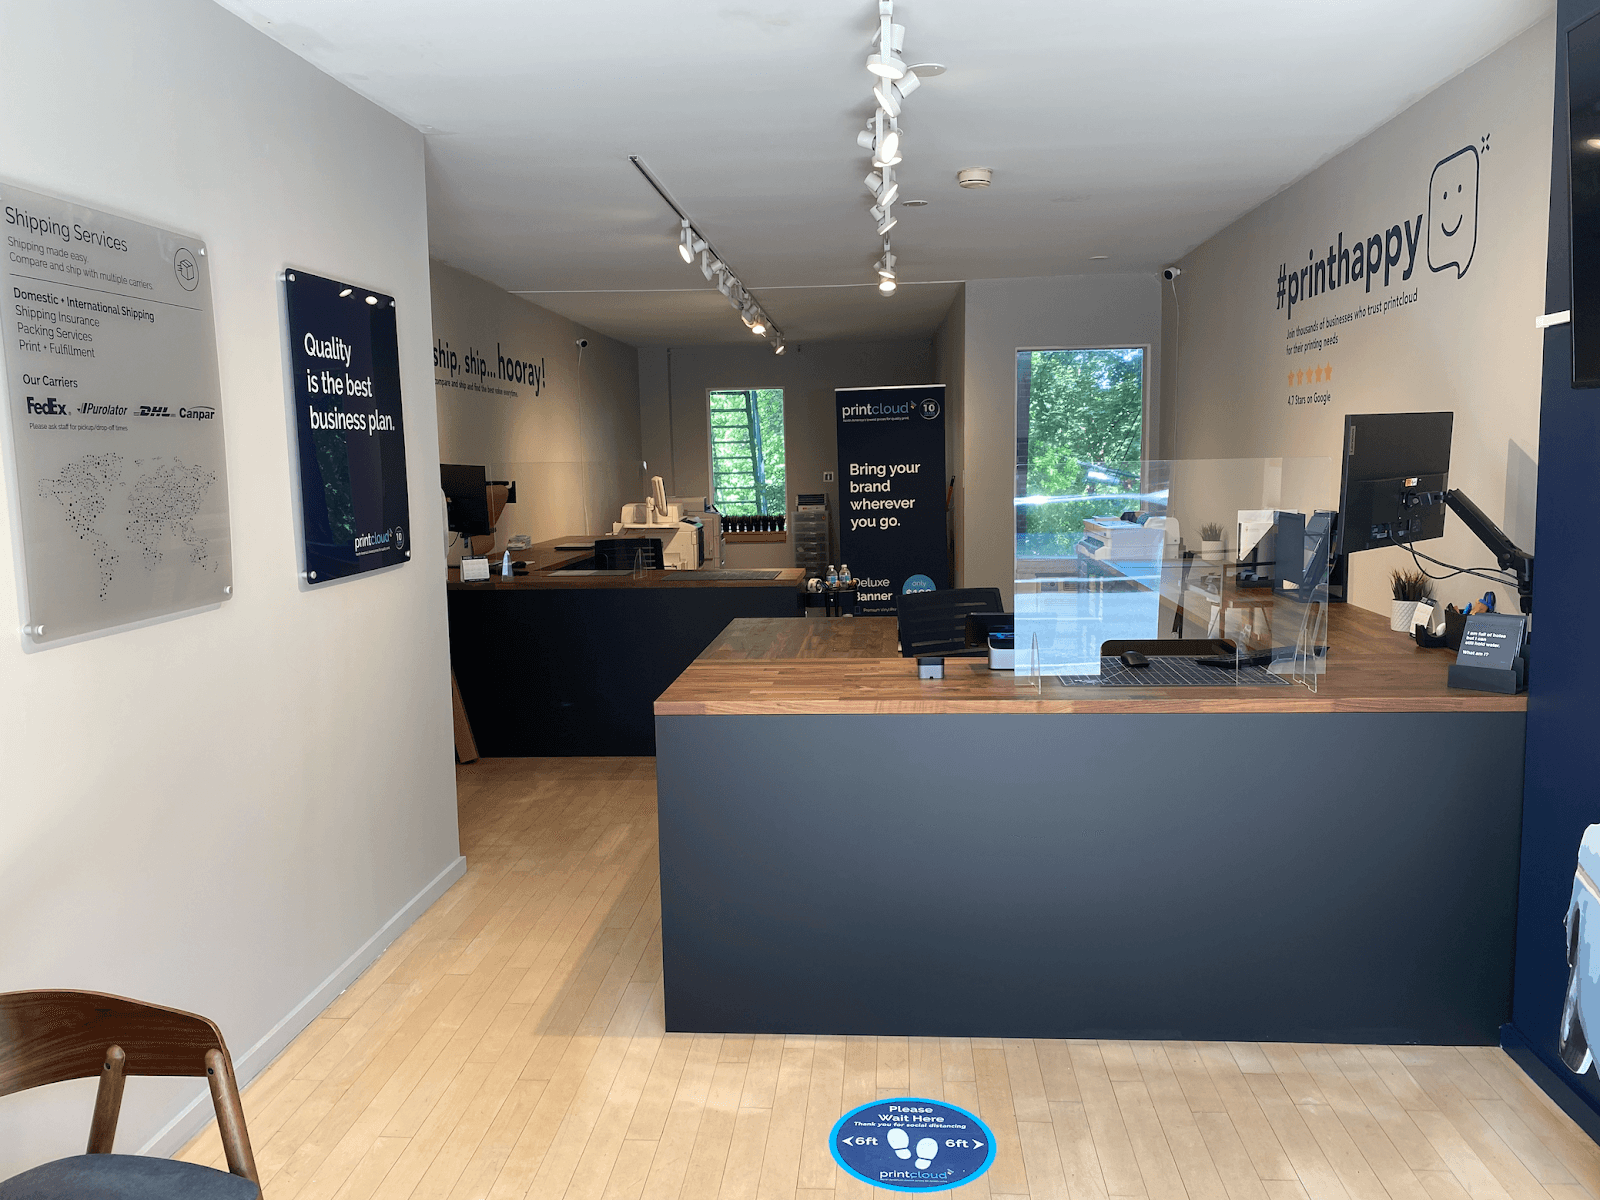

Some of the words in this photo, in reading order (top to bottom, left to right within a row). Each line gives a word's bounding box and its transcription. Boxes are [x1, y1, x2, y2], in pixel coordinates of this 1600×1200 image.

[5, 206, 70, 242] Shipping
[73, 224, 128, 252] Services
[7, 236, 44, 256] Shipping
[46, 246, 69, 259] made
[70, 252, 89, 265] easy.
[9, 251, 48, 269] Compare
[49, 261, 65, 272] and
[65, 263, 82, 278] ship
[83, 268, 99, 279] with
[99, 271, 128, 286] multiple
[1276, 214, 1423, 320] #printhappy
[13, 287, 59, 305] Domestic
[66, 296, 121, 315] International
[121, 305, 155, 323] Shipping
[1286, 328, 1295, 340] Join
[1296, 319, 1319, 337] thousands
[1319, 316, 1326, 330] of
[1326, 312, 1353, 329] businesses
[1353, 305, 1366, 319] who
[1367, 300, 1382, 316] trust
[1383, 287, 1418, 315] printcloud
[15, 304, 57, 324] Shipping
[58, 311, 100, 328] Insurance
[17, 321, 55, 340] Packing
[55, 327, 93, 342] Services
[19, 339, 42, 352] Print
[49, 342, 96, 358] Fulfillment
[304, 332, 351, 367] Quality
[1293, 341, 1304, 354] their
[1303, 337, 1323, 355] printing
[1323, 331, 1339, 347] needs
[22, 374, 41, 386] Our
[42, 375, 78, 388] Carriers
[306, 368, 319, 393] is
[321, 370, 344, 396] the
[345, 372, 373, 398] best
[1295, 394, 1306, 405] Stars
[1306, 396, 1313, 404] on
[1313, 389, 1331, 406] Google
[26, 396, 67, 416] FedEx
[86, 402, 128, 416] Purolator
[139, 405, 171, 417] DHL
[179, 407, 215, 421] Canpar
[842, 402, 909, 419] printcloud
[923, 403, 936, 412] 10
[29, 422, 48, 430] Please
[309, 405, 366, 430] business
[368, 408, 395, 436] plan.
[849, 462, 886, 478] Bring
[889, 463, 921, 478] your
[850, 479, 891, 493] brand
[850, 498, 916, 511] wherever
[850, 517, 876, 531] you
[879, 516, 901, 530] go.
[354, 530, 390, 552] printcloud
[395, 532, 403, 541] 10
[852, 576, 891, 588] Deluxe
[911, 580, 927, 588] only
[878, 1114, 910, 1122] Wait
[912, 1115, 945, 1123] Here
[889, 1105, 933, 1114] Please
[855, 1136, 878, 1146] 6ft
[945, 1139, 969, 1148] 6ft
[879, 1170, 947, 1179] printcloud
